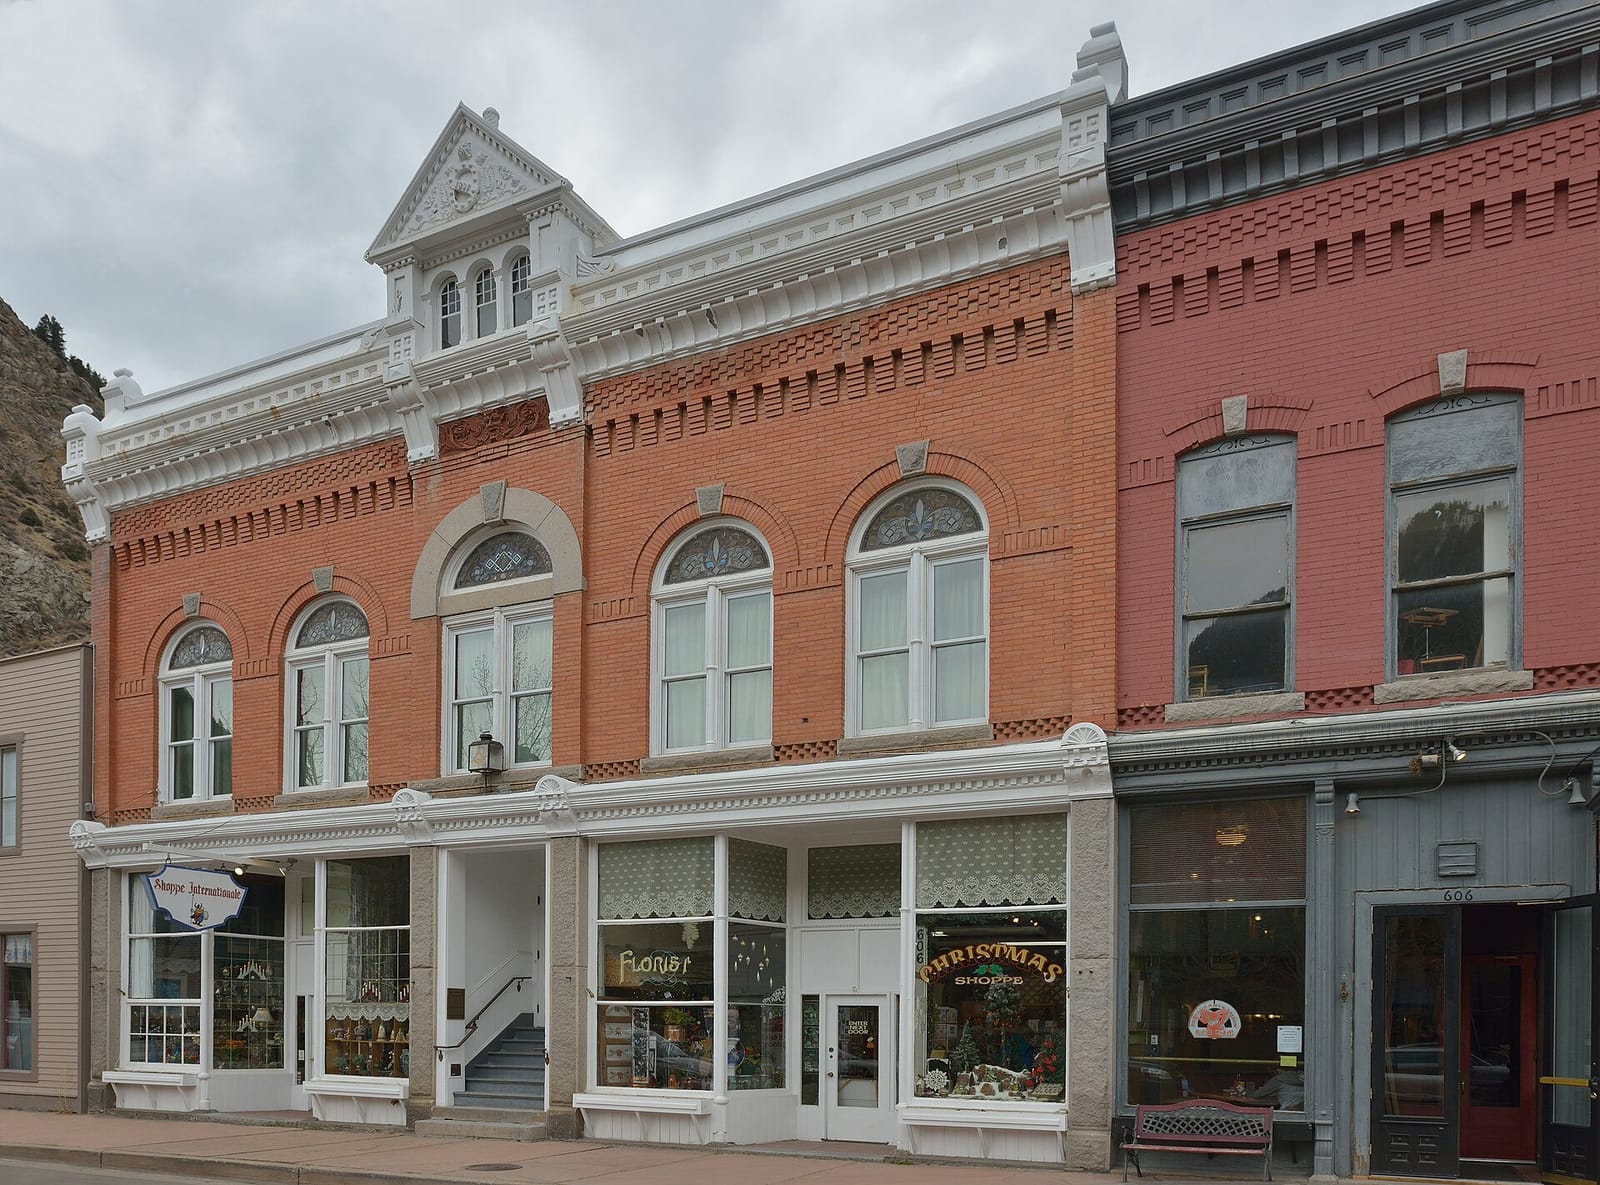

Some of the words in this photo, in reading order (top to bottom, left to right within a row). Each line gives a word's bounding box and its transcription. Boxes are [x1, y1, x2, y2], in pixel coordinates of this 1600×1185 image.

[154, 878, 186, 896] Shoppe
[188, 881, 241, 900] Internationale
[1443, 889, 1473, 901] 606
[916, 929, 924, 964] 606
[918, 943, 1063, 984] CHRISTMAS
[954, 975, 1024, 985] SHOPPE
